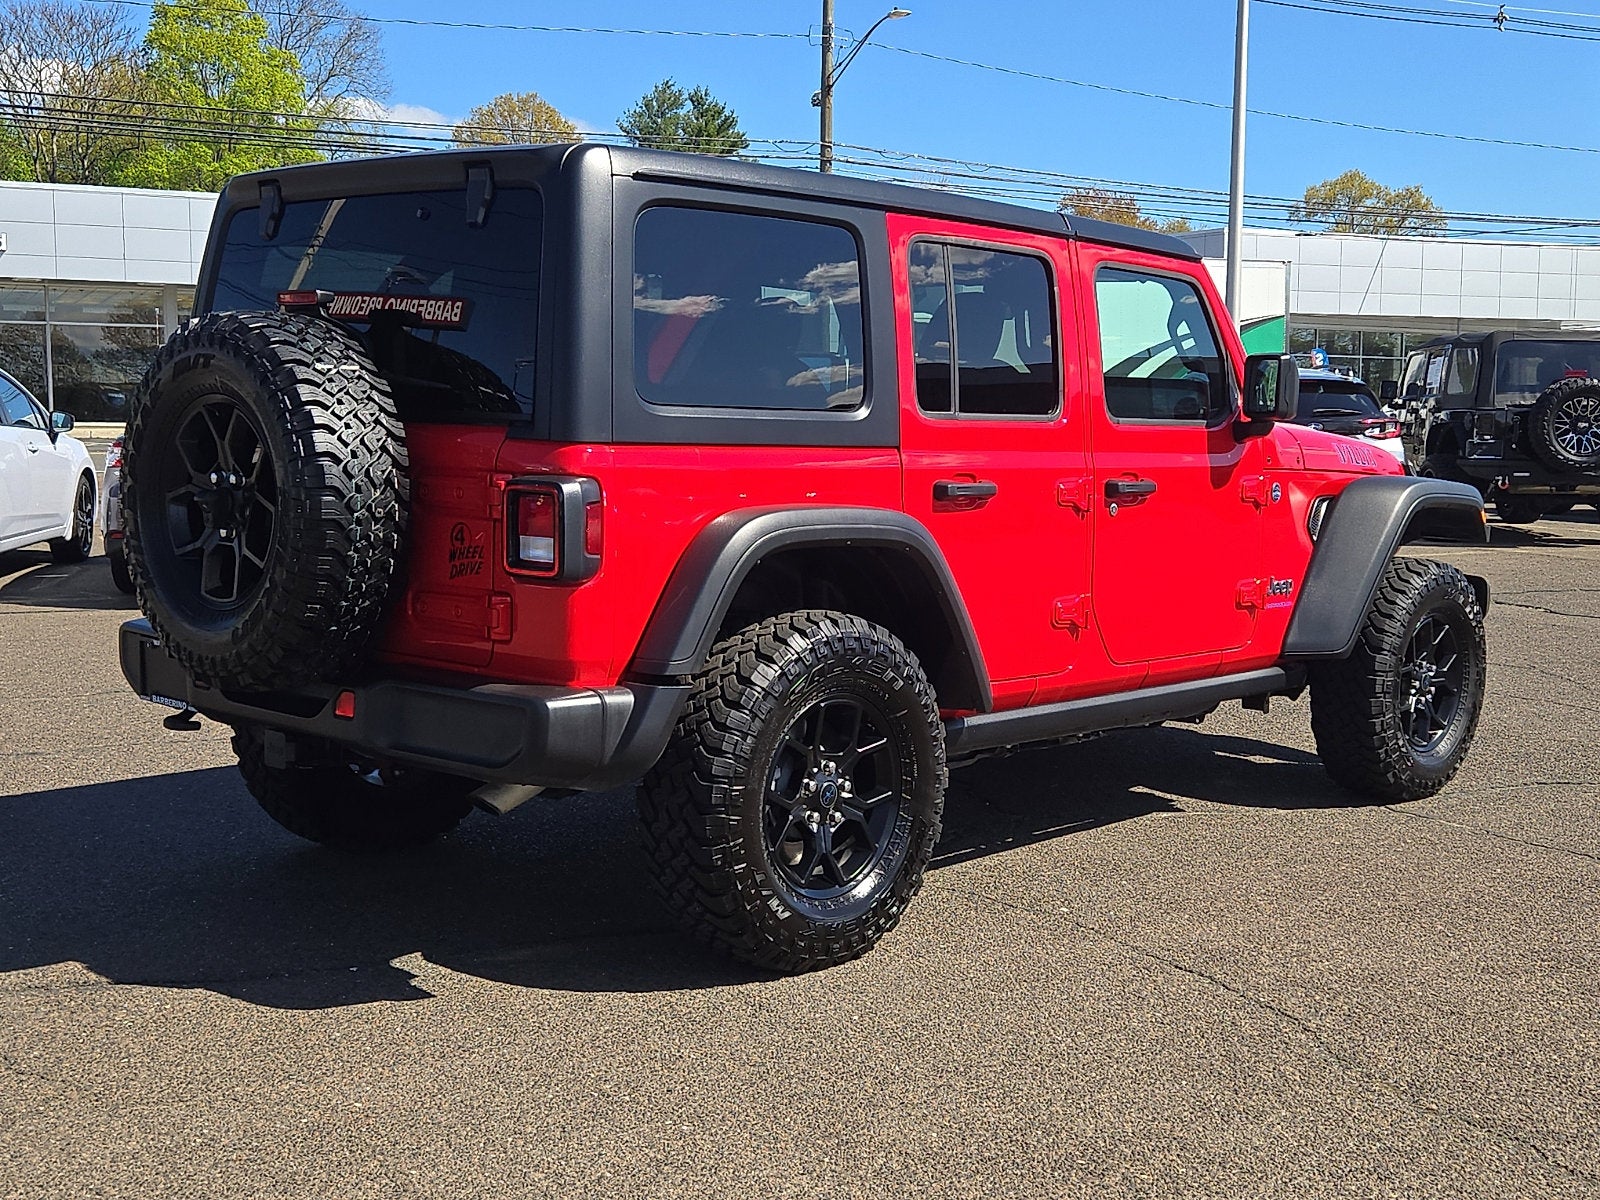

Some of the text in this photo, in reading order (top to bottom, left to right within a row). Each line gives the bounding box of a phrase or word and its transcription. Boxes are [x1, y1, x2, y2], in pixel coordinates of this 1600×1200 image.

[448, 545, 485, 563] WHEEL
[449, 560, 484, 580] DRIVE
[1266, 576, 1293, 598] Jeep
[151, 694, 187, 710] BARBERINO
